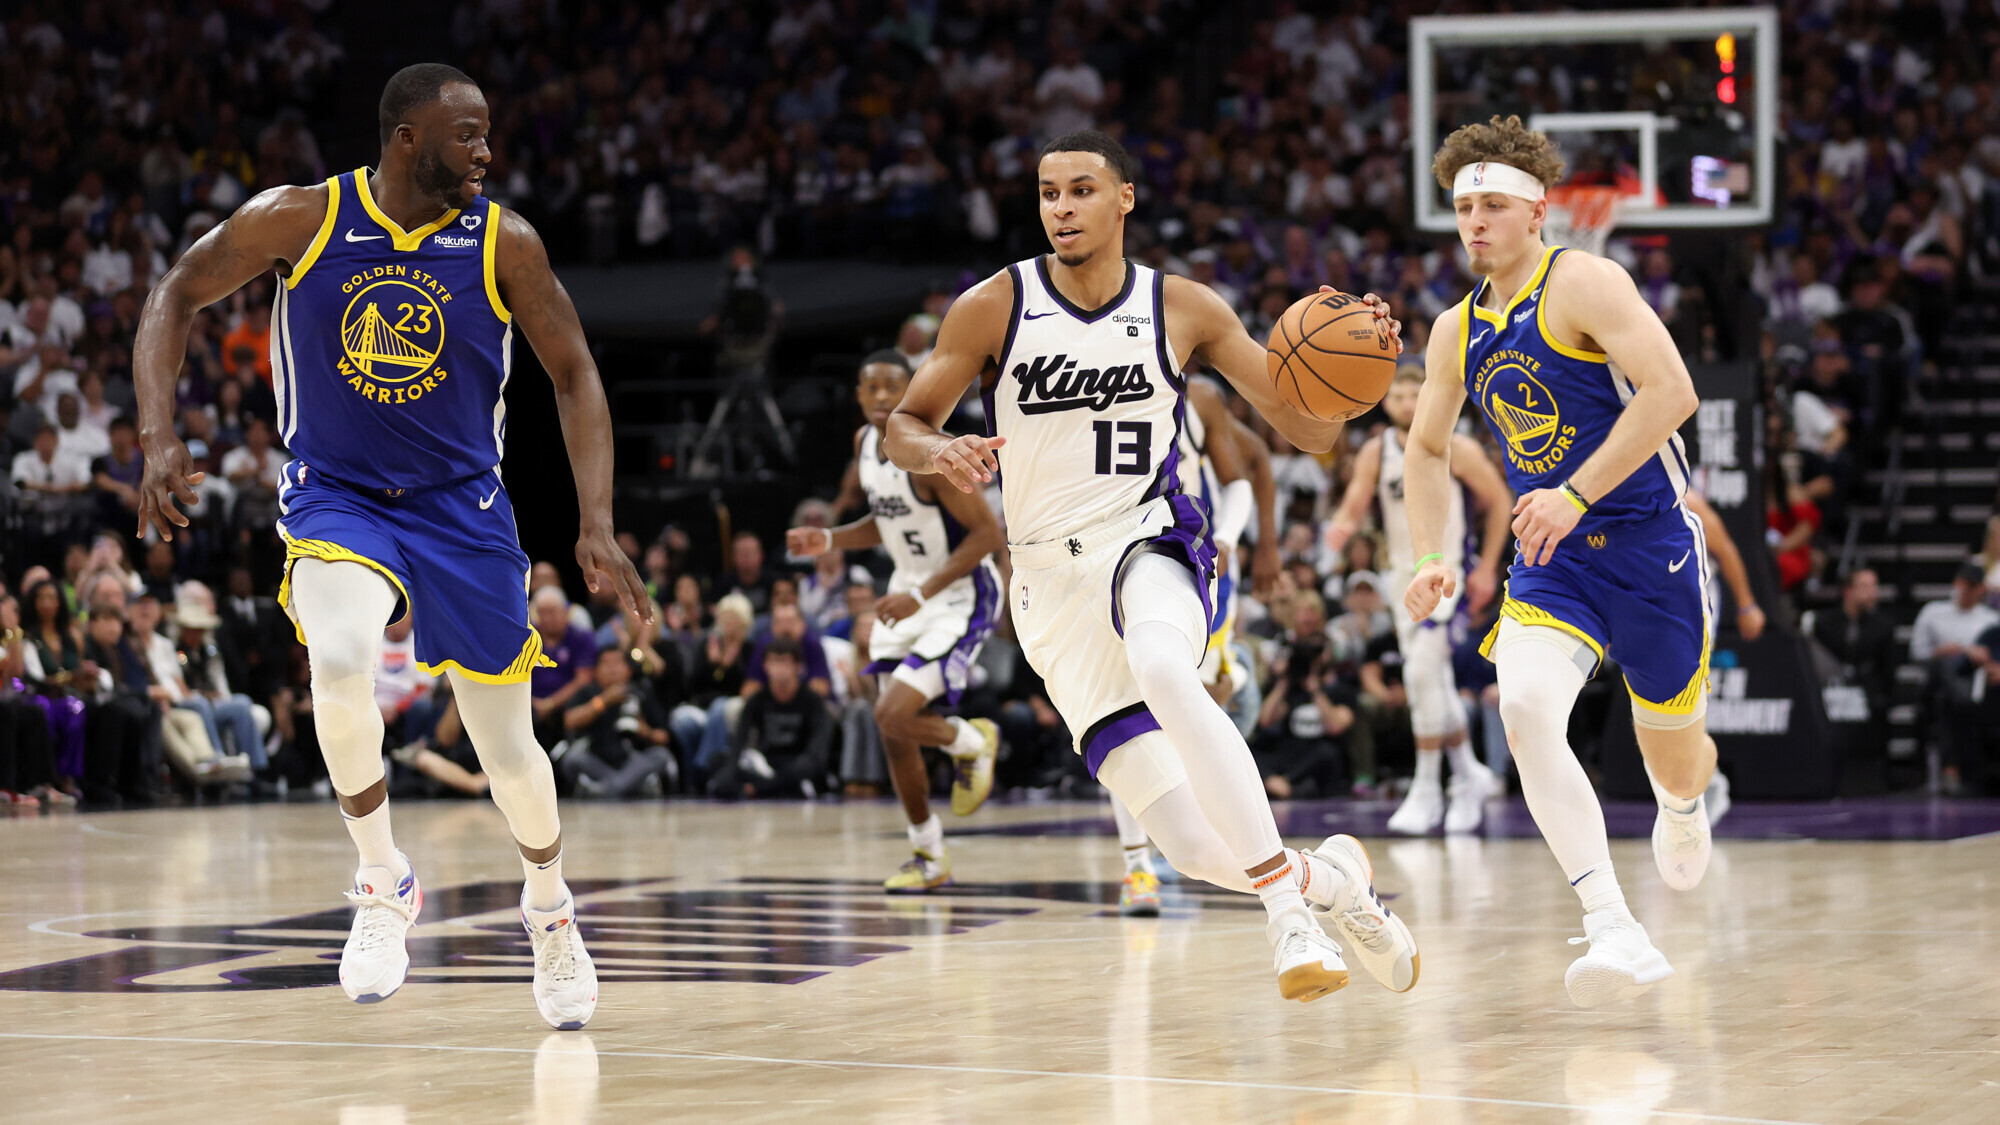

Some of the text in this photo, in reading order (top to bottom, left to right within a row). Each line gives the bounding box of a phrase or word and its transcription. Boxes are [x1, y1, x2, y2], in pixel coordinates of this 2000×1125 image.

[434, 235, 478, 248] Rakuten
[341, 264, 453, 304] GOLDEN STATE
[394, 302, 434, 334] 23
[1112, 314, 1151, 325] dialpad
[336, 355, 448, 404] WARRIORS
[1011, 353, 1155, 416] Kings
[1474, 349, 1542, 393] GOLDEN STATE
[1517, 382, 1539, 409] 2
[1092, 420, 1153, 476] 13
[1506, 424, 1577, 475] WARRIORS
[902, 529, 927, 556] 5
